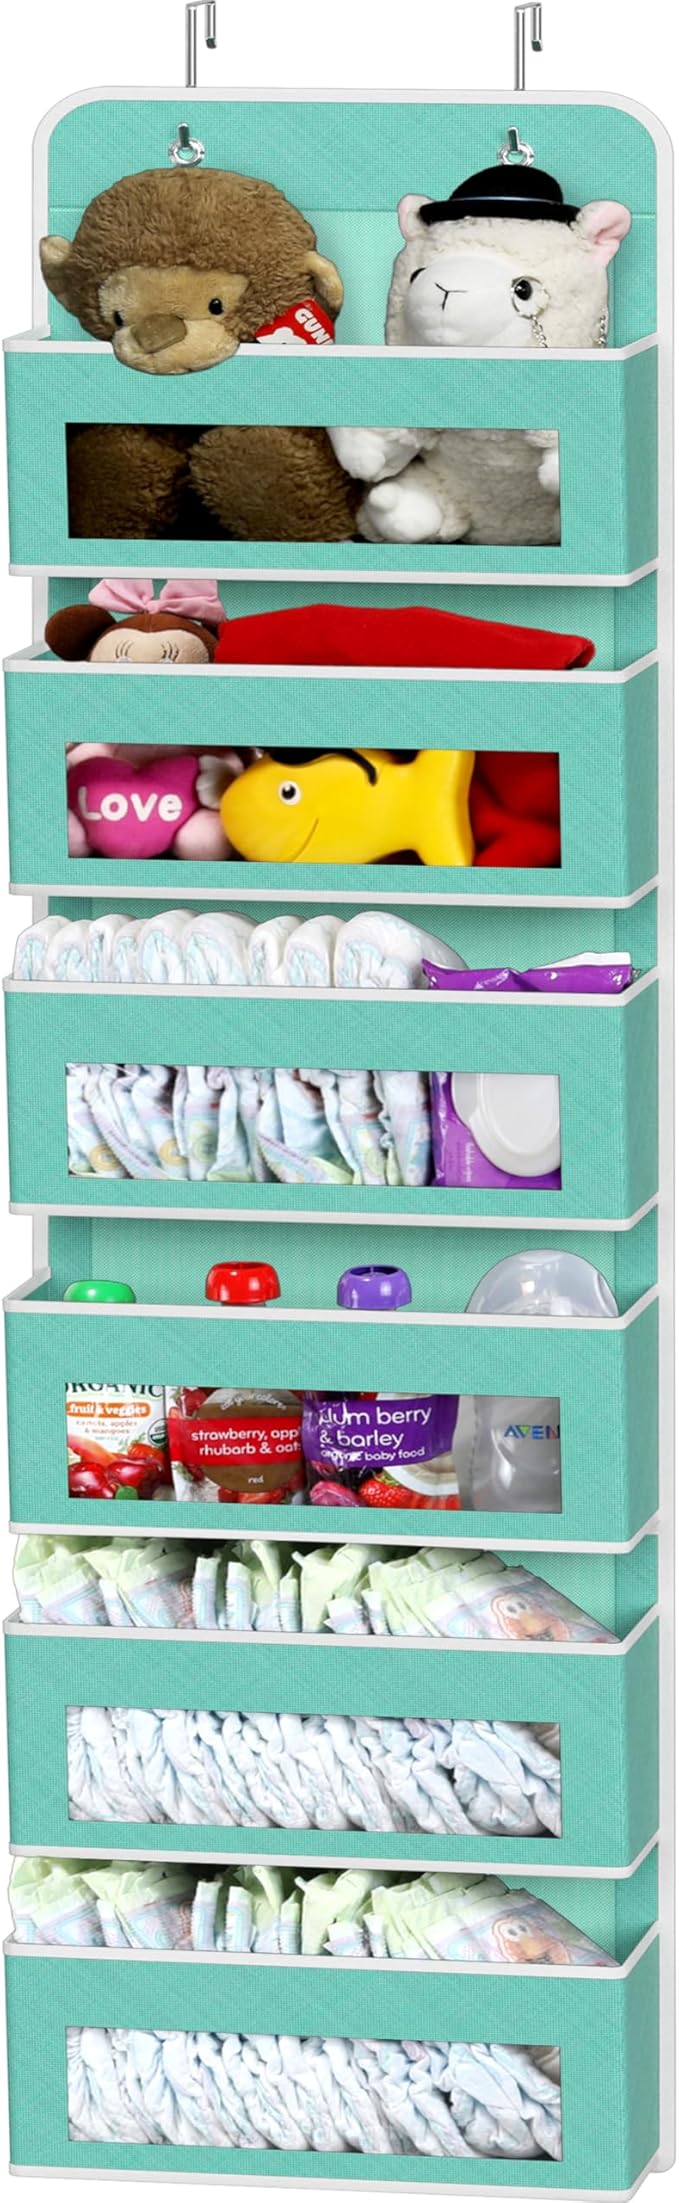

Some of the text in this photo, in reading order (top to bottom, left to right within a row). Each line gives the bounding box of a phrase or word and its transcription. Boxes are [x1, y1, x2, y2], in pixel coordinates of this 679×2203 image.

[78, 786, 182, 822] Love
[376, 1405, 432, 1425] berry
[191, 1428, 300, 1442] strawberry, app
[336, 1429, 404, 1449] barley
[199, 1442, 256, 1456] rhubarb
[259, 1441, 272, 1454] &
[364, 1449, 396, 1462] baby
[398, 1447, 426, 1459] food
[248, 1474, 264, 1484] red
